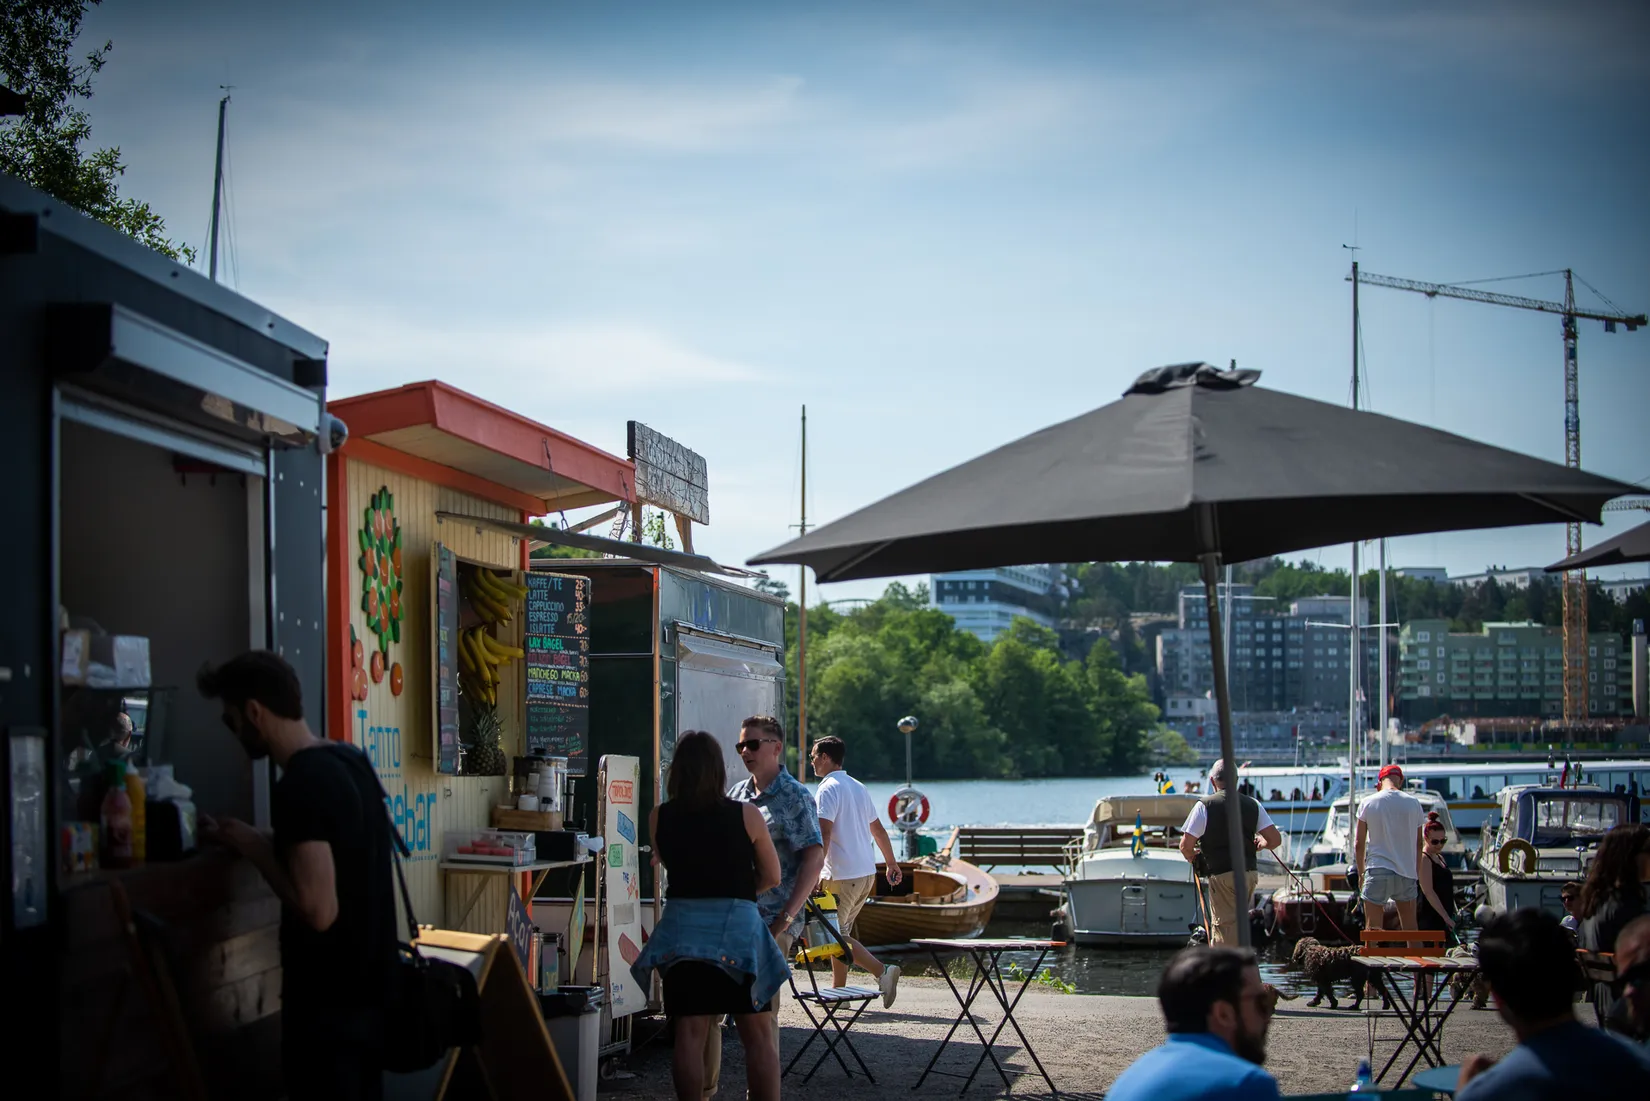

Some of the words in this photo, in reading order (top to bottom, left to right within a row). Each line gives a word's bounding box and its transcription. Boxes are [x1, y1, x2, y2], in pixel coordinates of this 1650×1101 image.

[528, 590, 548, 600] LATTE
[529, 600, 564, 612] CAPPUCCINO
[529, 612, 558, 622] ESPRESSO
[530, 622, 556, 634] ISLATTE
[528, 637, 541, 649] LAX
[542, 636, 564, 650] BAGEL
[528, 668, 558, 680] MANCHEGO
[528, 682, 554, 695] CAPRESE
